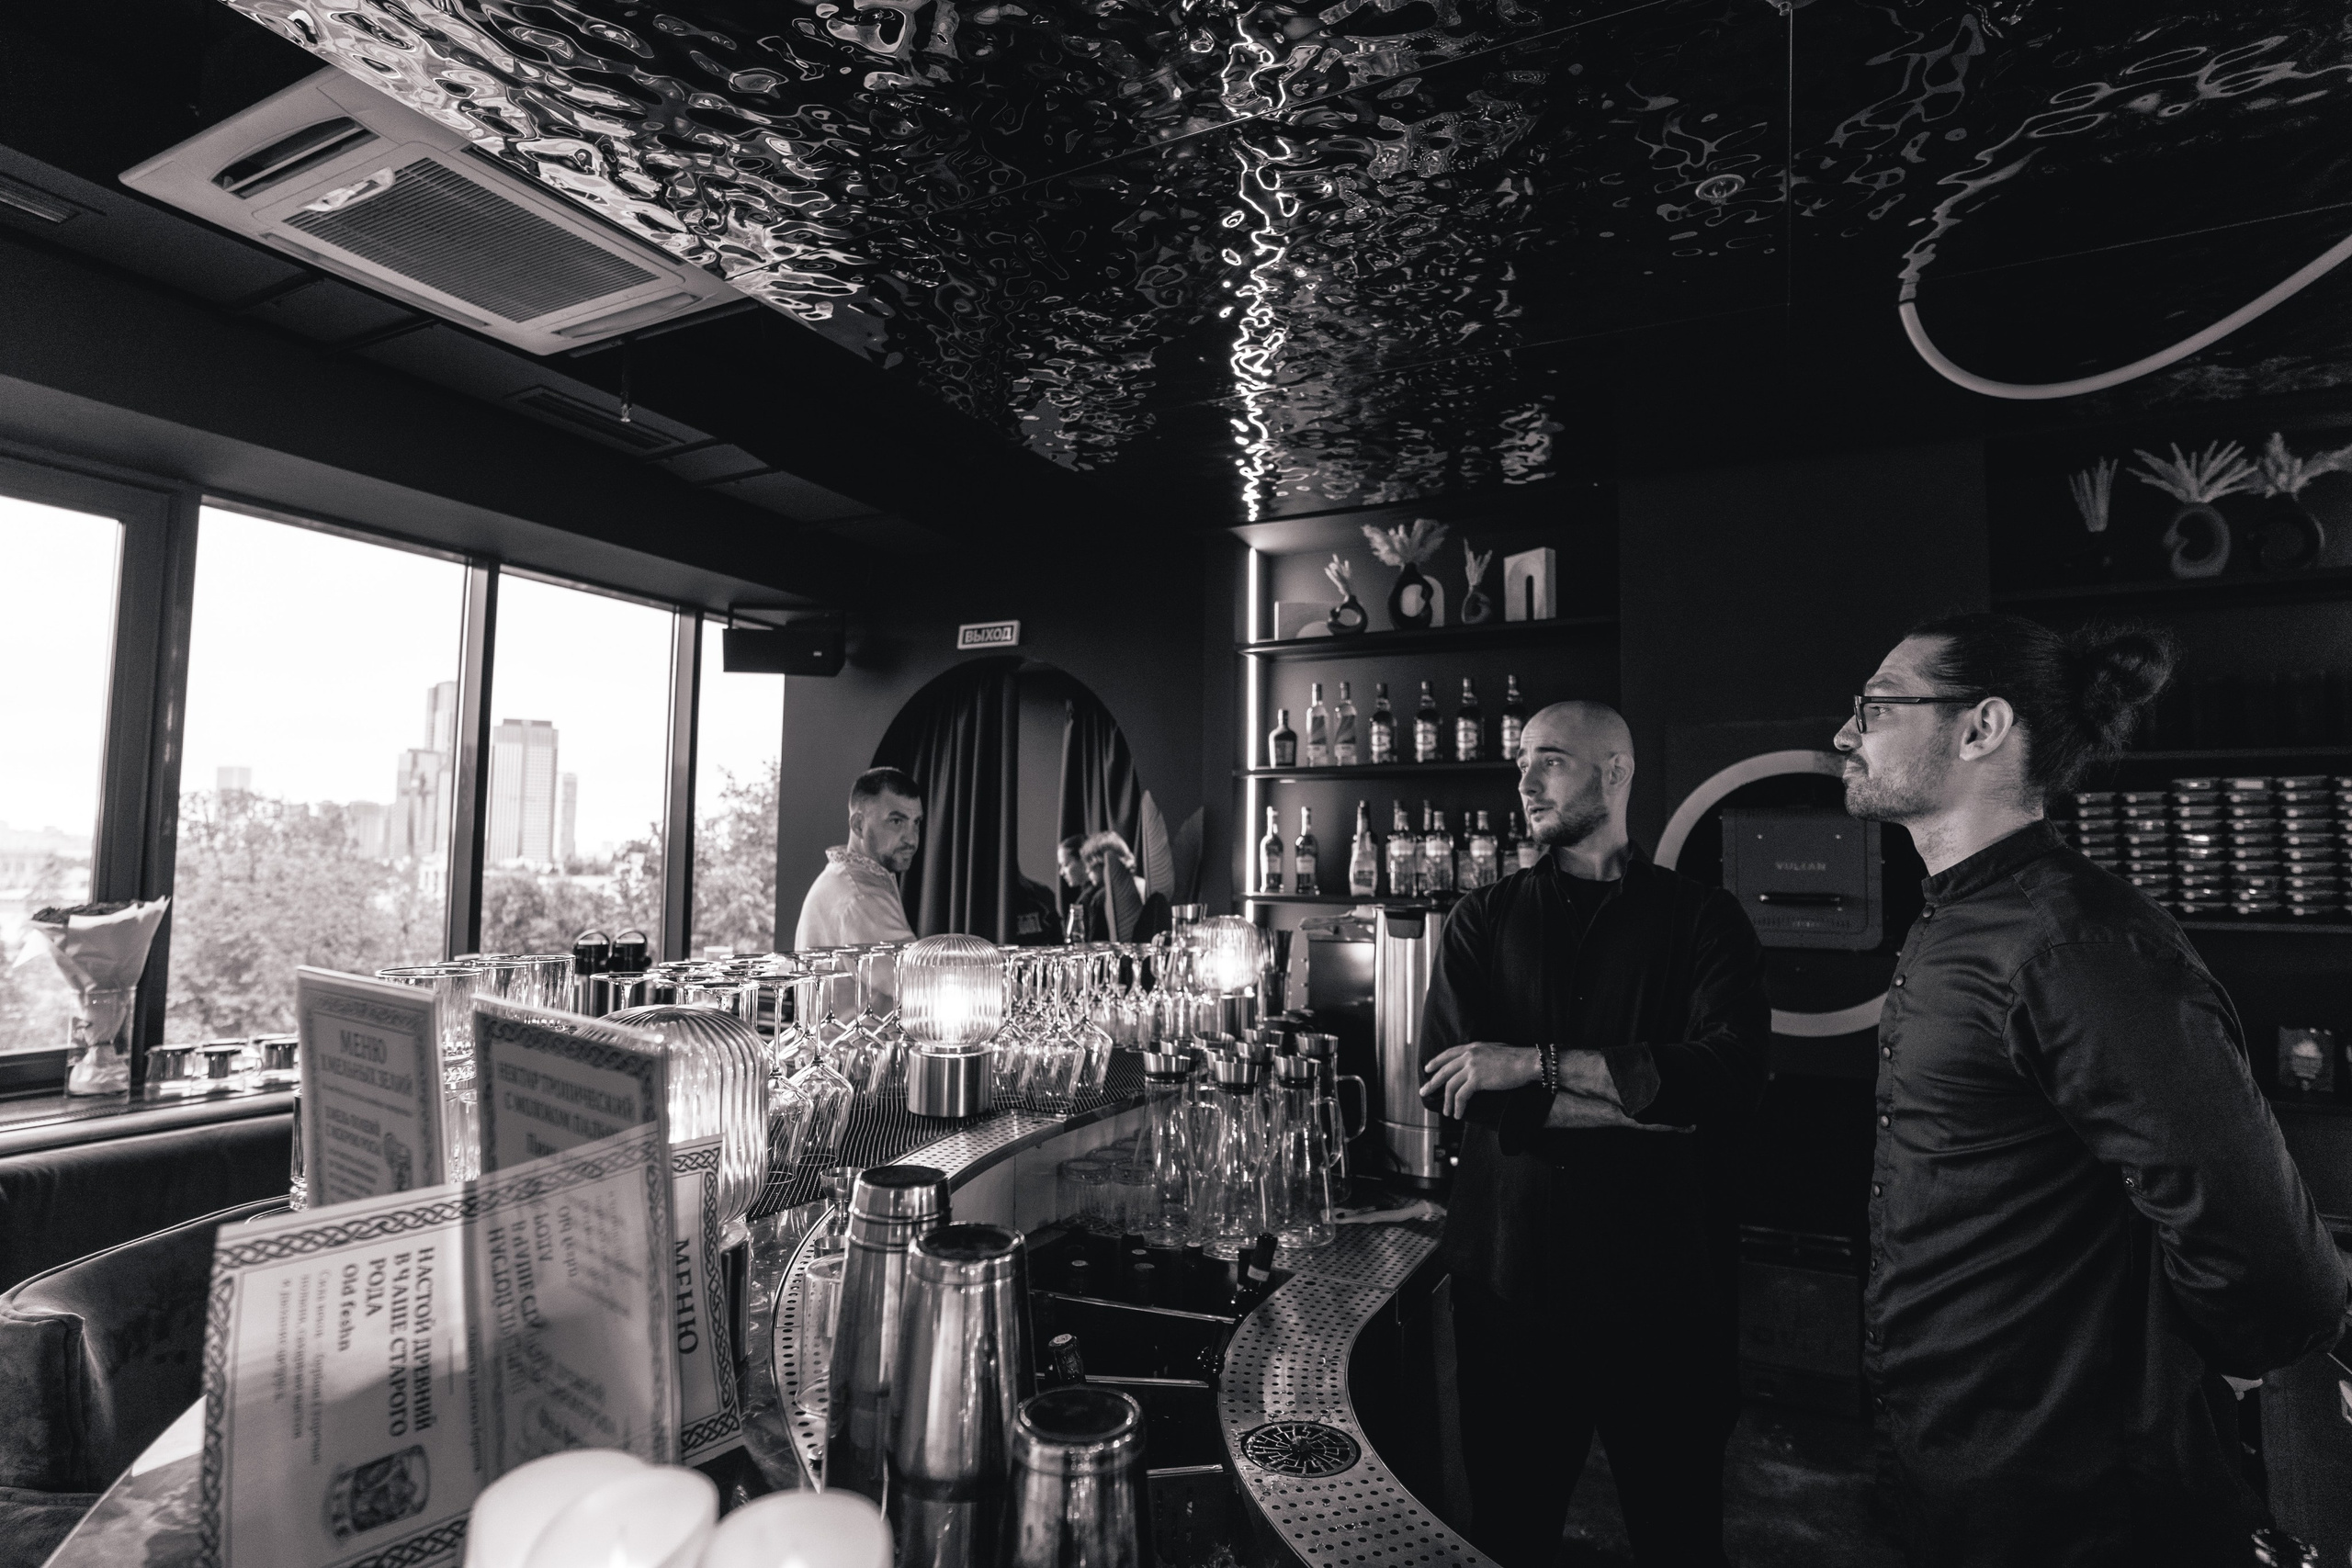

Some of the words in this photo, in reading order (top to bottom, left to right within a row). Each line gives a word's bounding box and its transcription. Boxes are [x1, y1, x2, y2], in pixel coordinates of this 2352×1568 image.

[964, 626, 1012, 644] ВЫХОД
[340, 1262, 359, 1297] Old
[365, 1257, 387, 1317] РОДА
[393, 1251, 413, 1267] В
[413, 1247, 436, 1335] НАСТОЙ
[390, 1268, 411, 1335] ЧАШЕ
[675, 1236, 698, 1355] МЕНЮ
[388, 1337, 410, 1438] СТАРОГО
[413, 1337, 437, 1433] ДРЕВНИЙ
